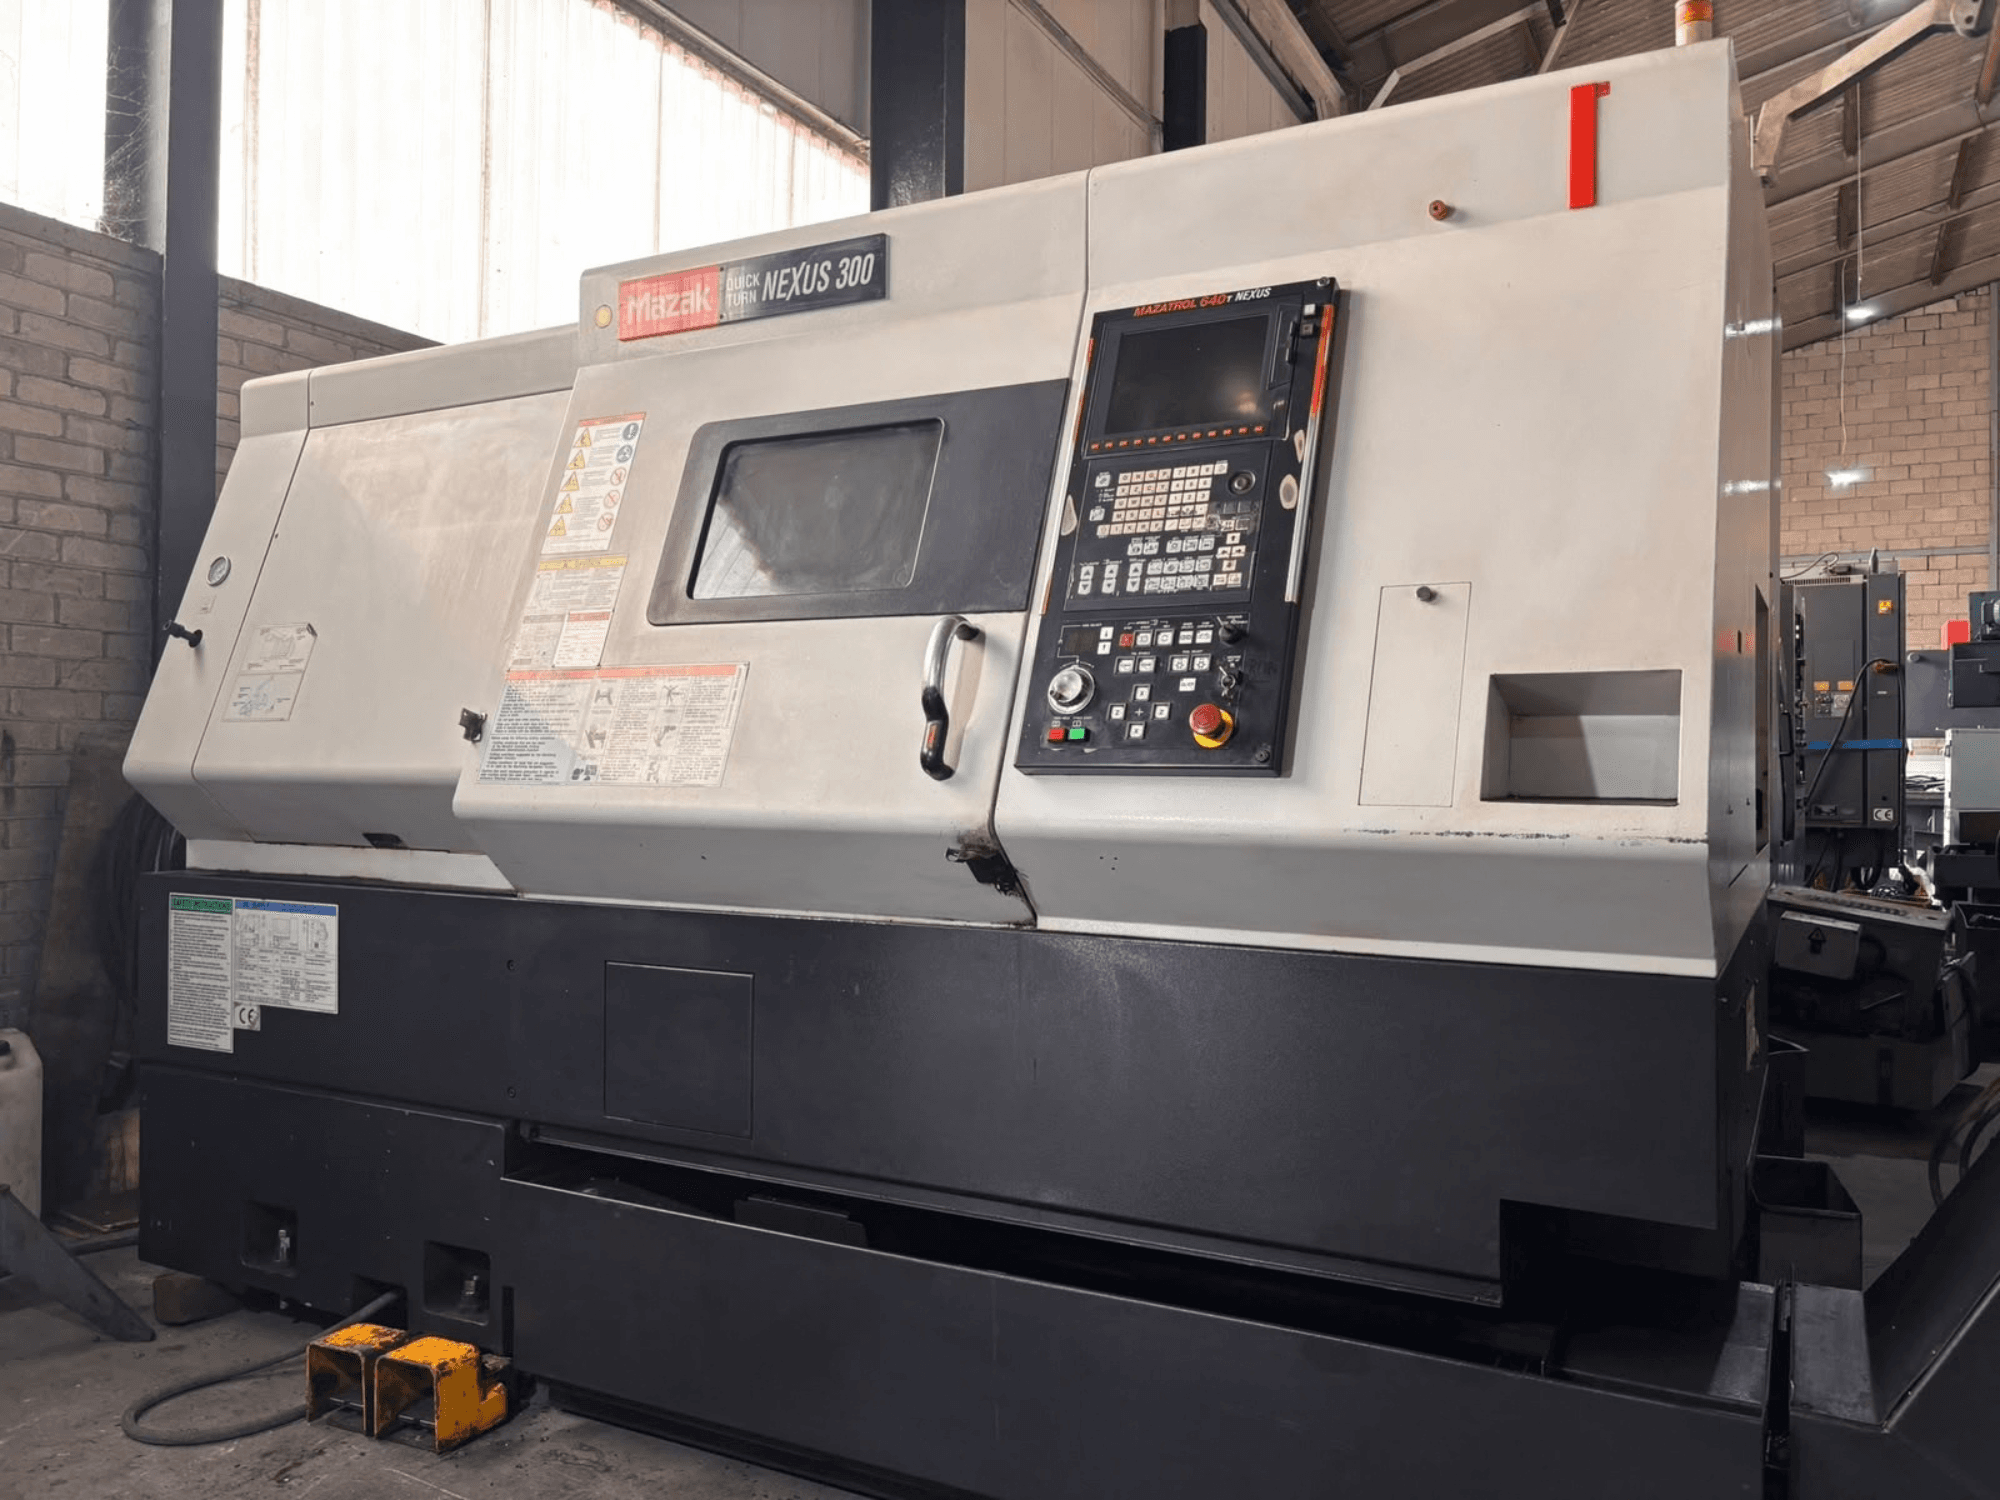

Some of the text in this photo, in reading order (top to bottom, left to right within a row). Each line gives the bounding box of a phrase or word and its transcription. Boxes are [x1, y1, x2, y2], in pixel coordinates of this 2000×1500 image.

[726, 272, 760, 292] QUICK
[762, 253, 875, 302] NEXUS 300
[627, 283, 713, 324] Mazak
[725, 290, 757, 307] TURN
[1133, 299, 1197, 317] MAZATROL
[1234, 287, 1272, 302] NEXUS
